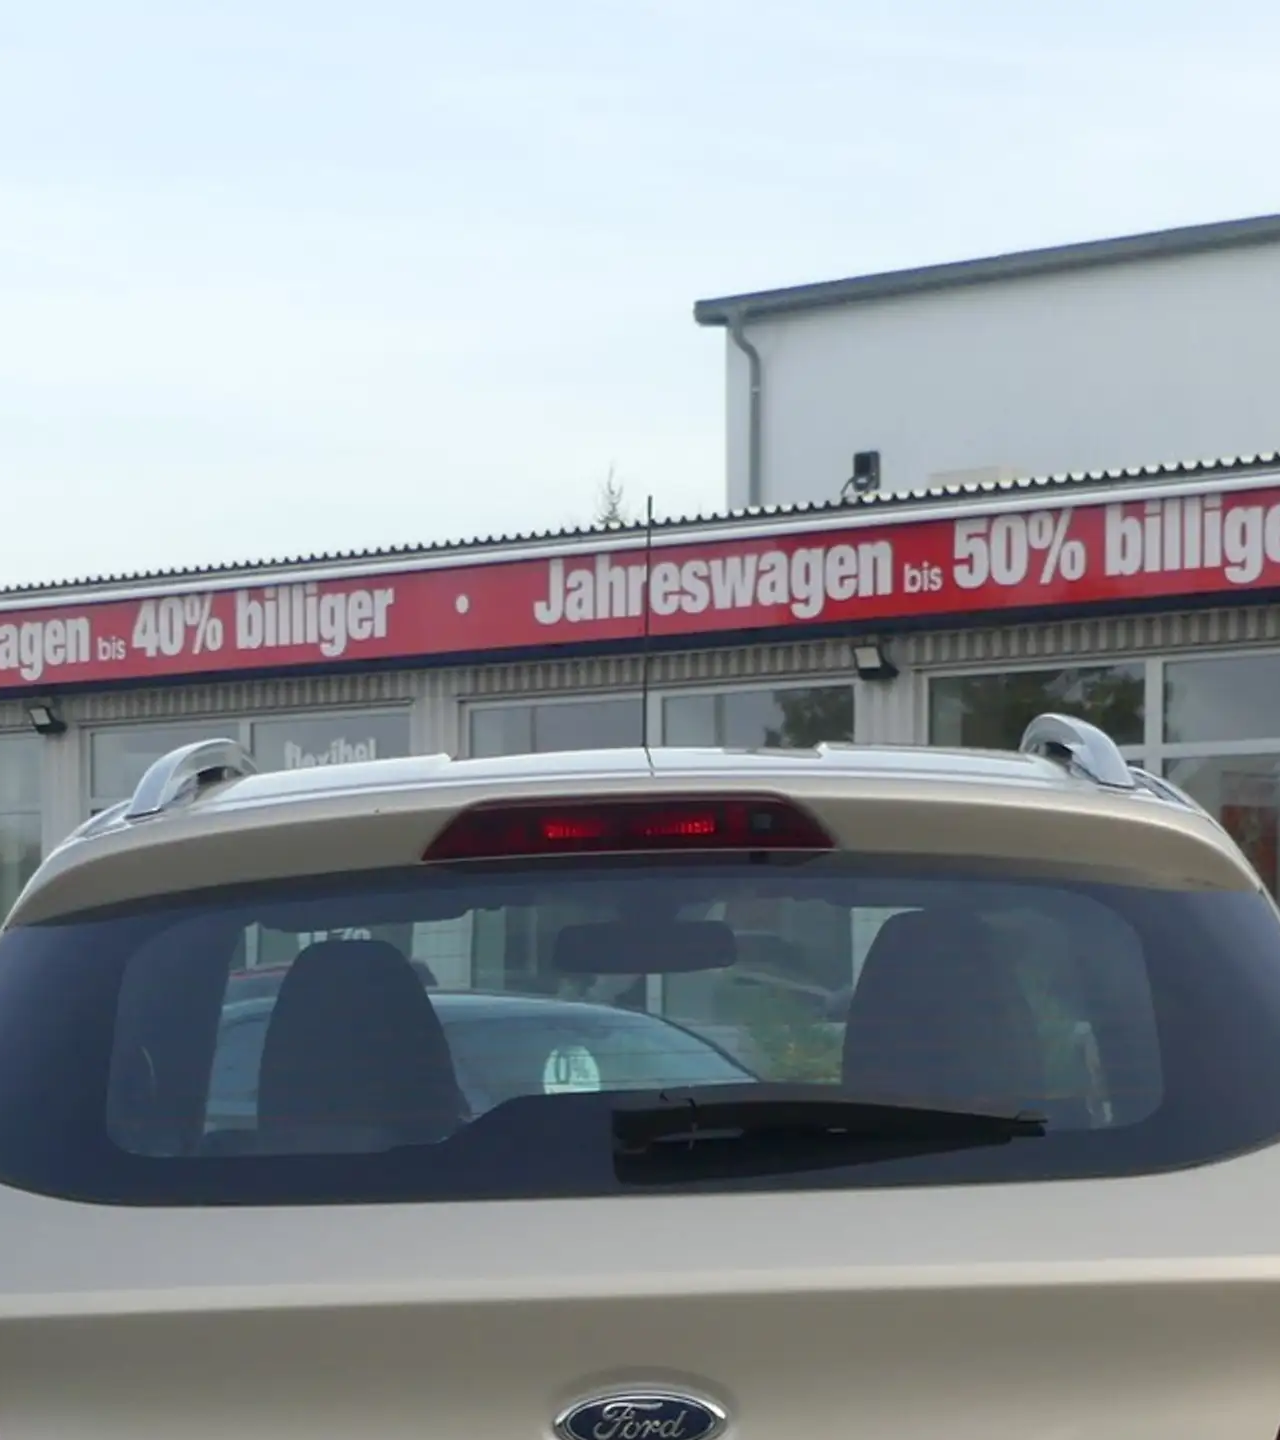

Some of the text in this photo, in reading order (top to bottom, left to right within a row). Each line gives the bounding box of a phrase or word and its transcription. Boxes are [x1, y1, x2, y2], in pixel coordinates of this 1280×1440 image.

[97, 634, 126, 661] bis
[131, 590, 223, 658] 40%
[235, 582, 394, 657] billiger
[534, 539, 893, 626] Jahreswagen
[903, 562, 943, 594] bis
[953, 507, 1086, 589] 50%
[593, 1402, 686, 1440] Ford
